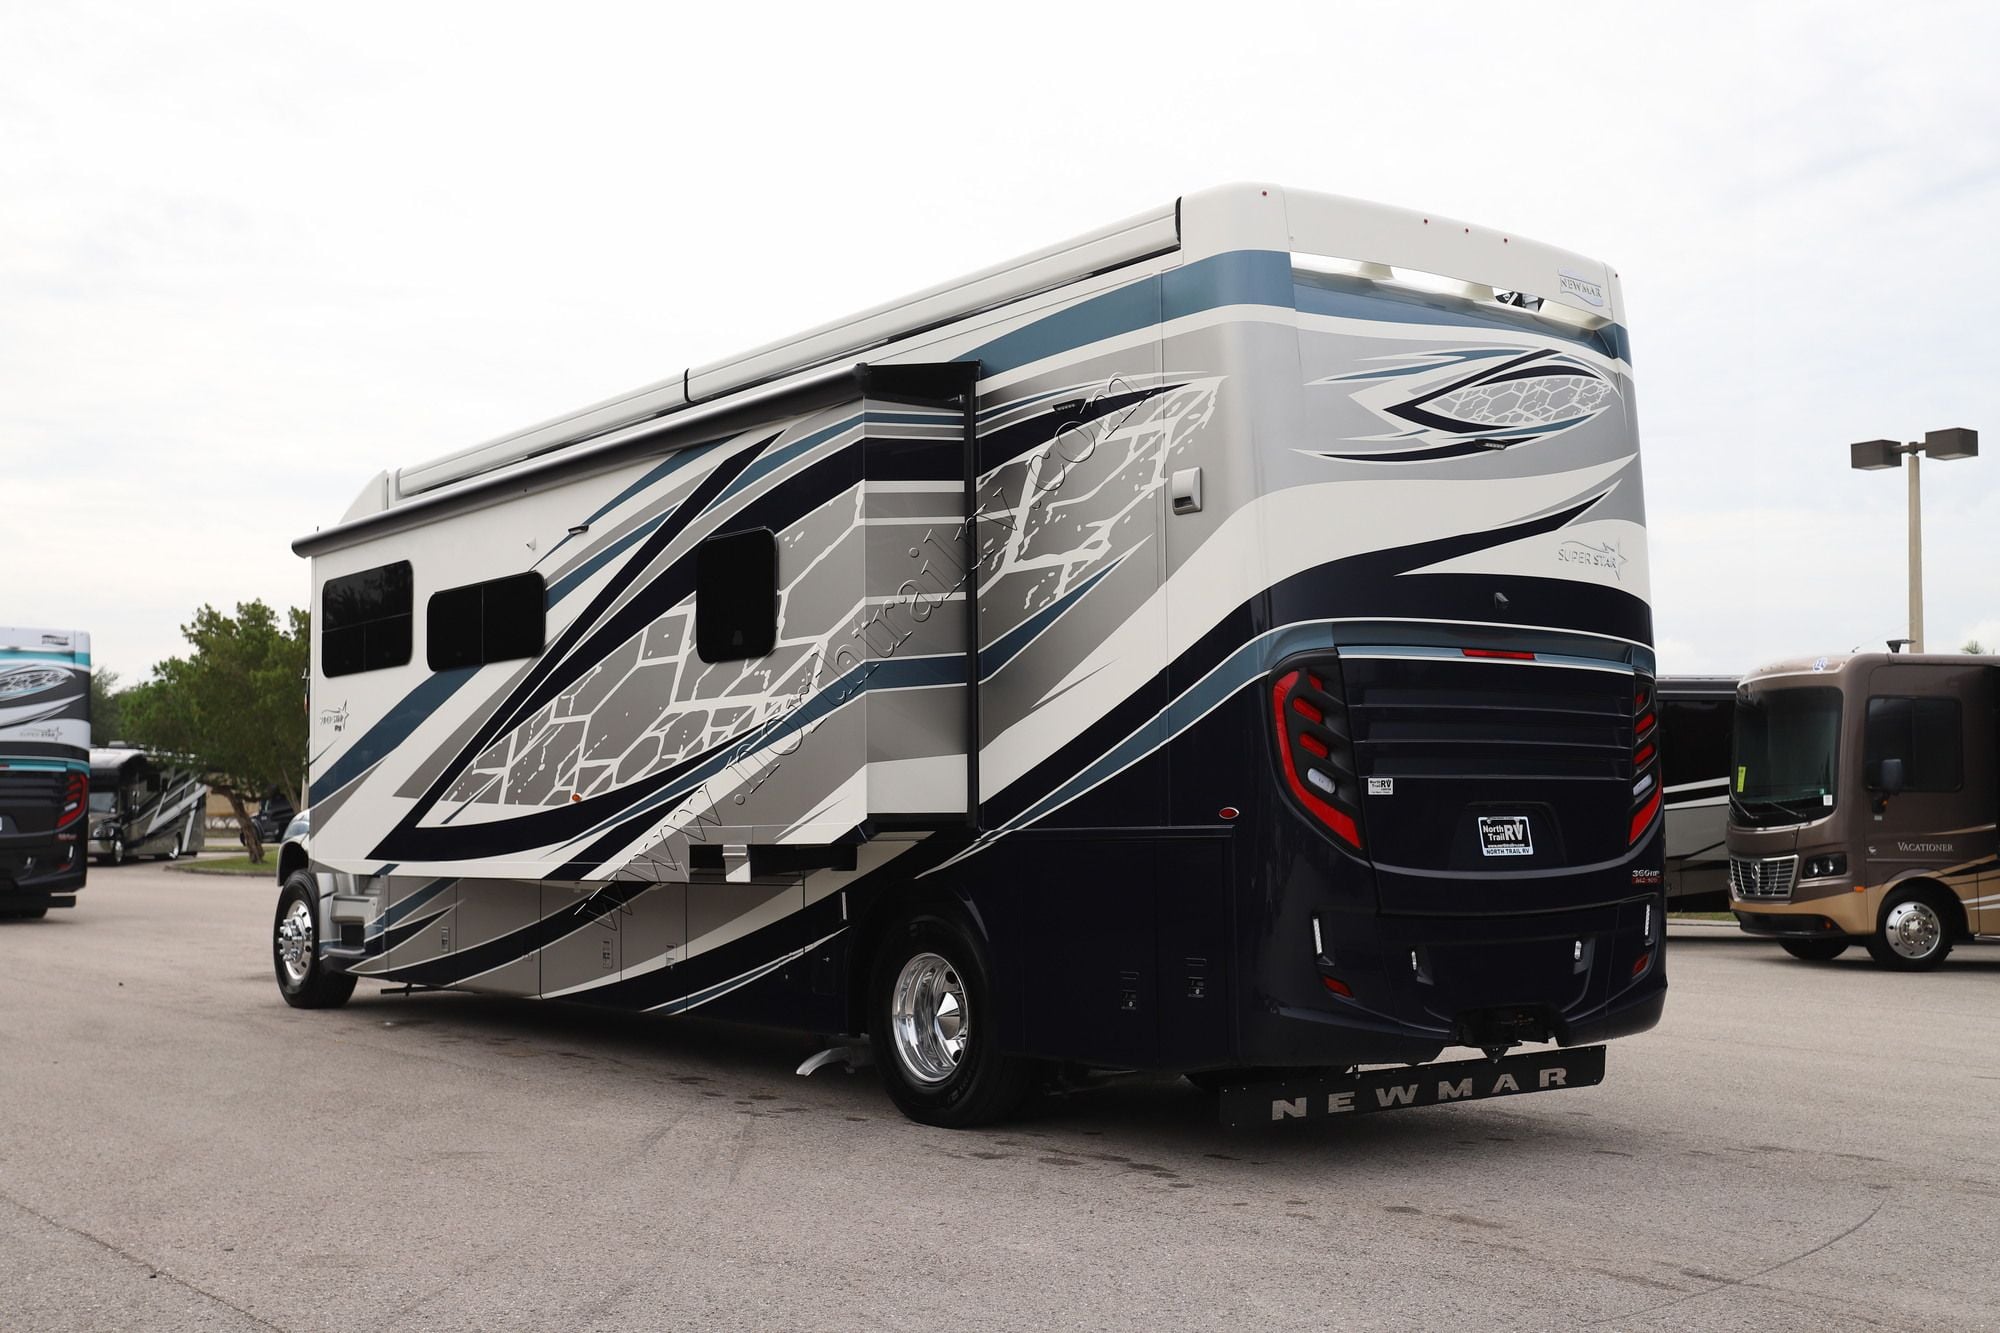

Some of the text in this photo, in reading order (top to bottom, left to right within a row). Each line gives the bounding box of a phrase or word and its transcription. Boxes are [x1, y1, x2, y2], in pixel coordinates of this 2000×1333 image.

[1560, 278, 1602, 298] NEWMAR
[1558, 548, 1617, 569] SUPER STAR
[1482, 824, 1523, 841] North RV
[1487, 832, 1505, 841] Trail
[1897, 841, 1953, 852] VACATIONER
[1271, 1067, 1568, 1121] NEWMAR
